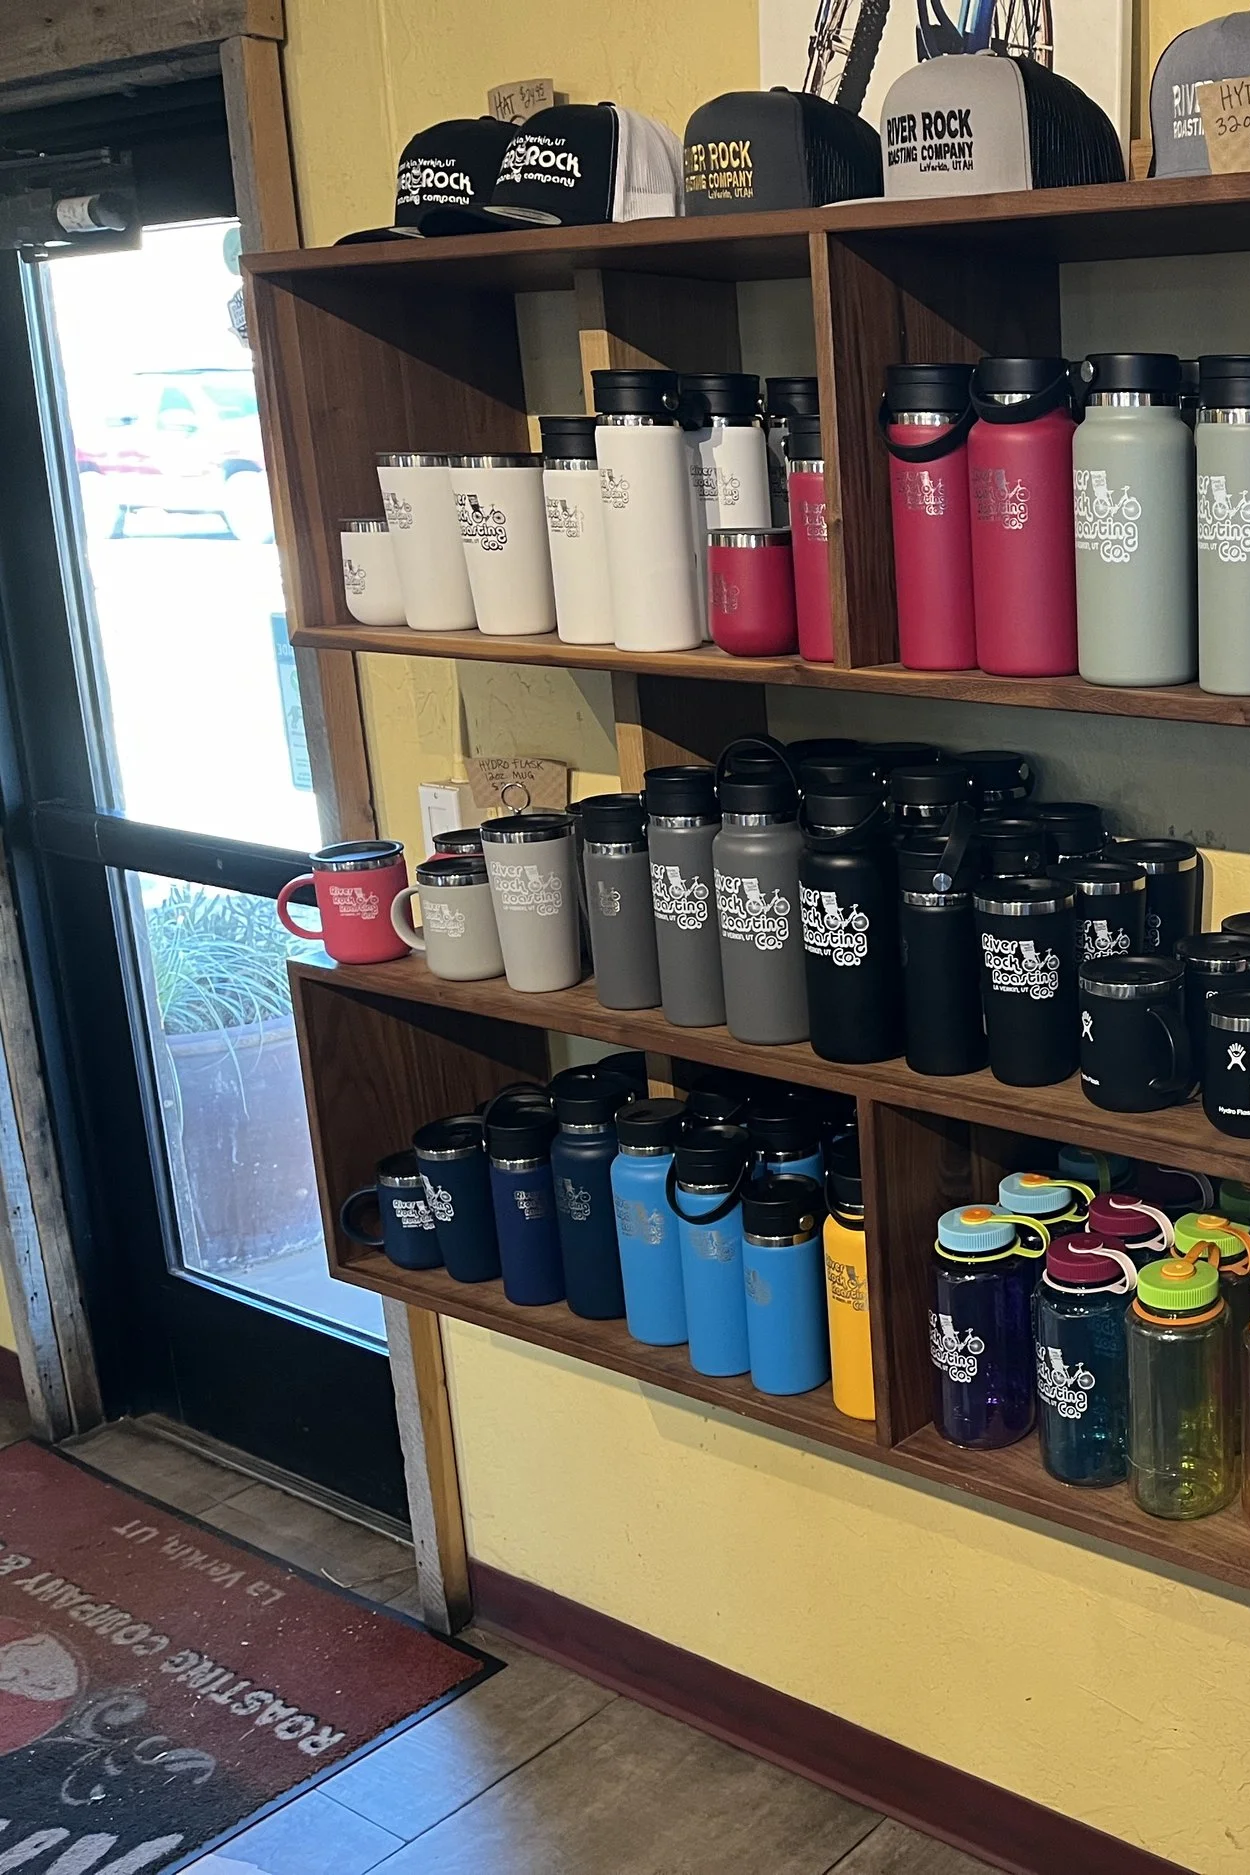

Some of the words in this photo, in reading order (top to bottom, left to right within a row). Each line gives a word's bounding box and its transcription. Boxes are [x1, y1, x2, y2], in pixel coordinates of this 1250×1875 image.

[494, 91, 515, 119] HAT
[887, 114, 918, 148] RIVER
[921, 109, 973, 141] ROCK
[555, 138, 567, 146] UT
[921, 141, 974, 161] COMPANY
[446, 159, 457, 167] UT
[525, 145, 581, 177] ROCK
[708, 140, 753, 171] ROCK
[952, 160, 974, 170] UTAH
[422, 168, 475, 196] ROCK
[524, 172, 575, 187] company
[709, 171, 753, 189] COMPANY
[423, 194, 470, 206] company
[481, 537, 503, 551] Co.
[1100, 540, 1131, 563] Co.
[1218, 540, 1248, 562] Co.
[479, 759, 510, 771] HYDRO
[512, 759, 544, 770] FLASK
[512, 771, 535, 780] MUG
[491, 861, 523, 878] River
[495, 876, 528, 895] Rock
[501, 890, 562, 908] Roasting
[537, 904, 559, 916] Co.
[677, 914, 702, 930] Co.
[721, 912, 789, 941] Roasting
[755, 932, 783, 950] Co.
[982, 932, 1018, 955] River
[833, 947, 861, 967] Co.
[984, 951, 1023, 974] Rock
[993, 968, 1059, 991] Roasting
[1029, 985, 1055, 1000] Co.
[1218, 1105, 1236, 1117] Hydro
[949, 1366, 972, 1384] Co.
[1058, 1401, 1082, 1419] Co.
[111, 1519, 162, 1546] UT
[161, 1531, 247, 1589] Verkin,
[246, 1580, 286, 1607] La
[15, 1571, 171, 1658] COMPANY
[159, 1647, 347, 1757] ROASTING
